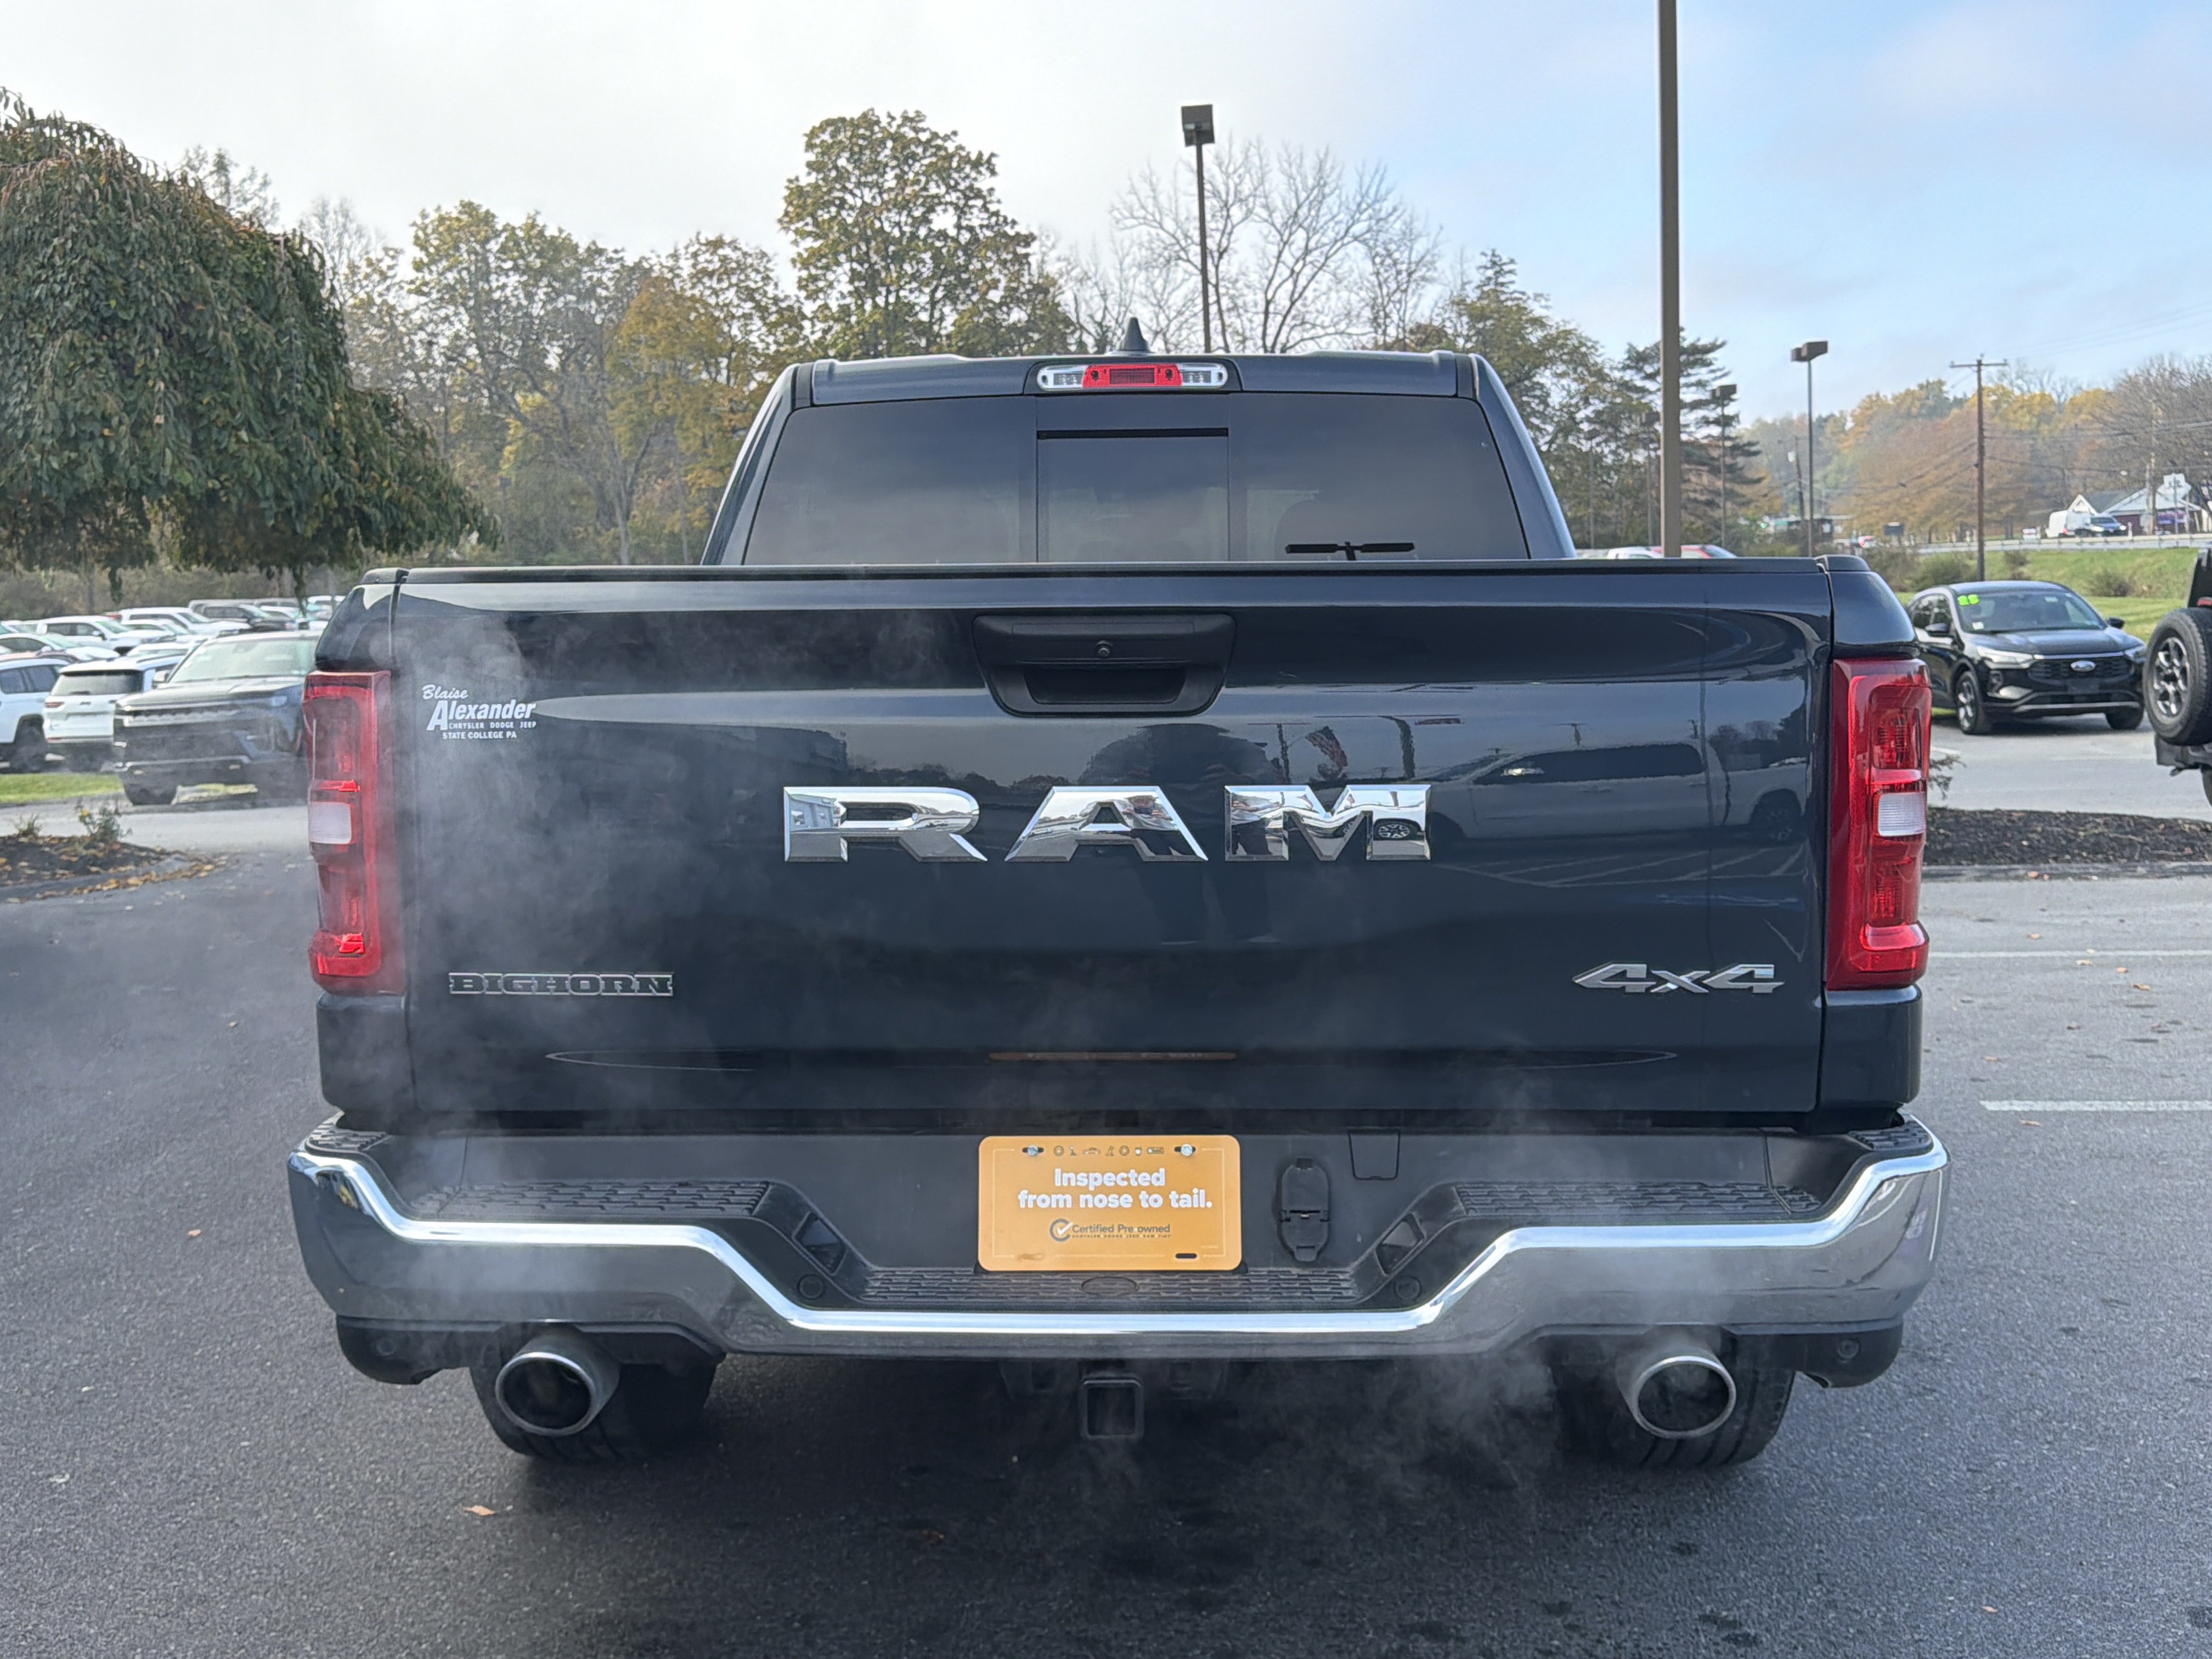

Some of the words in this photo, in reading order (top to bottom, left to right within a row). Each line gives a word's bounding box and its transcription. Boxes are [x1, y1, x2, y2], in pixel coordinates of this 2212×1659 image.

[421, 684, 469, 699] Blaise
[426, 699, 537, 731] Alexander
[442, 731, 466, 740] STATE
[783, 785, 1431, 862] RAM
[448, 972, 673, 996] BIGHORN
[1054, 1168, 1166, 1190] Inspected
[1018, 1189, 1072, 1208] from
[1080, 1194, 1133, 1208] nose
[1139, 1190, 1163, 1208] to
[1169, 1188, 1213, 1208] tail.
[1072, 1224, 1114, 1233] Certified
